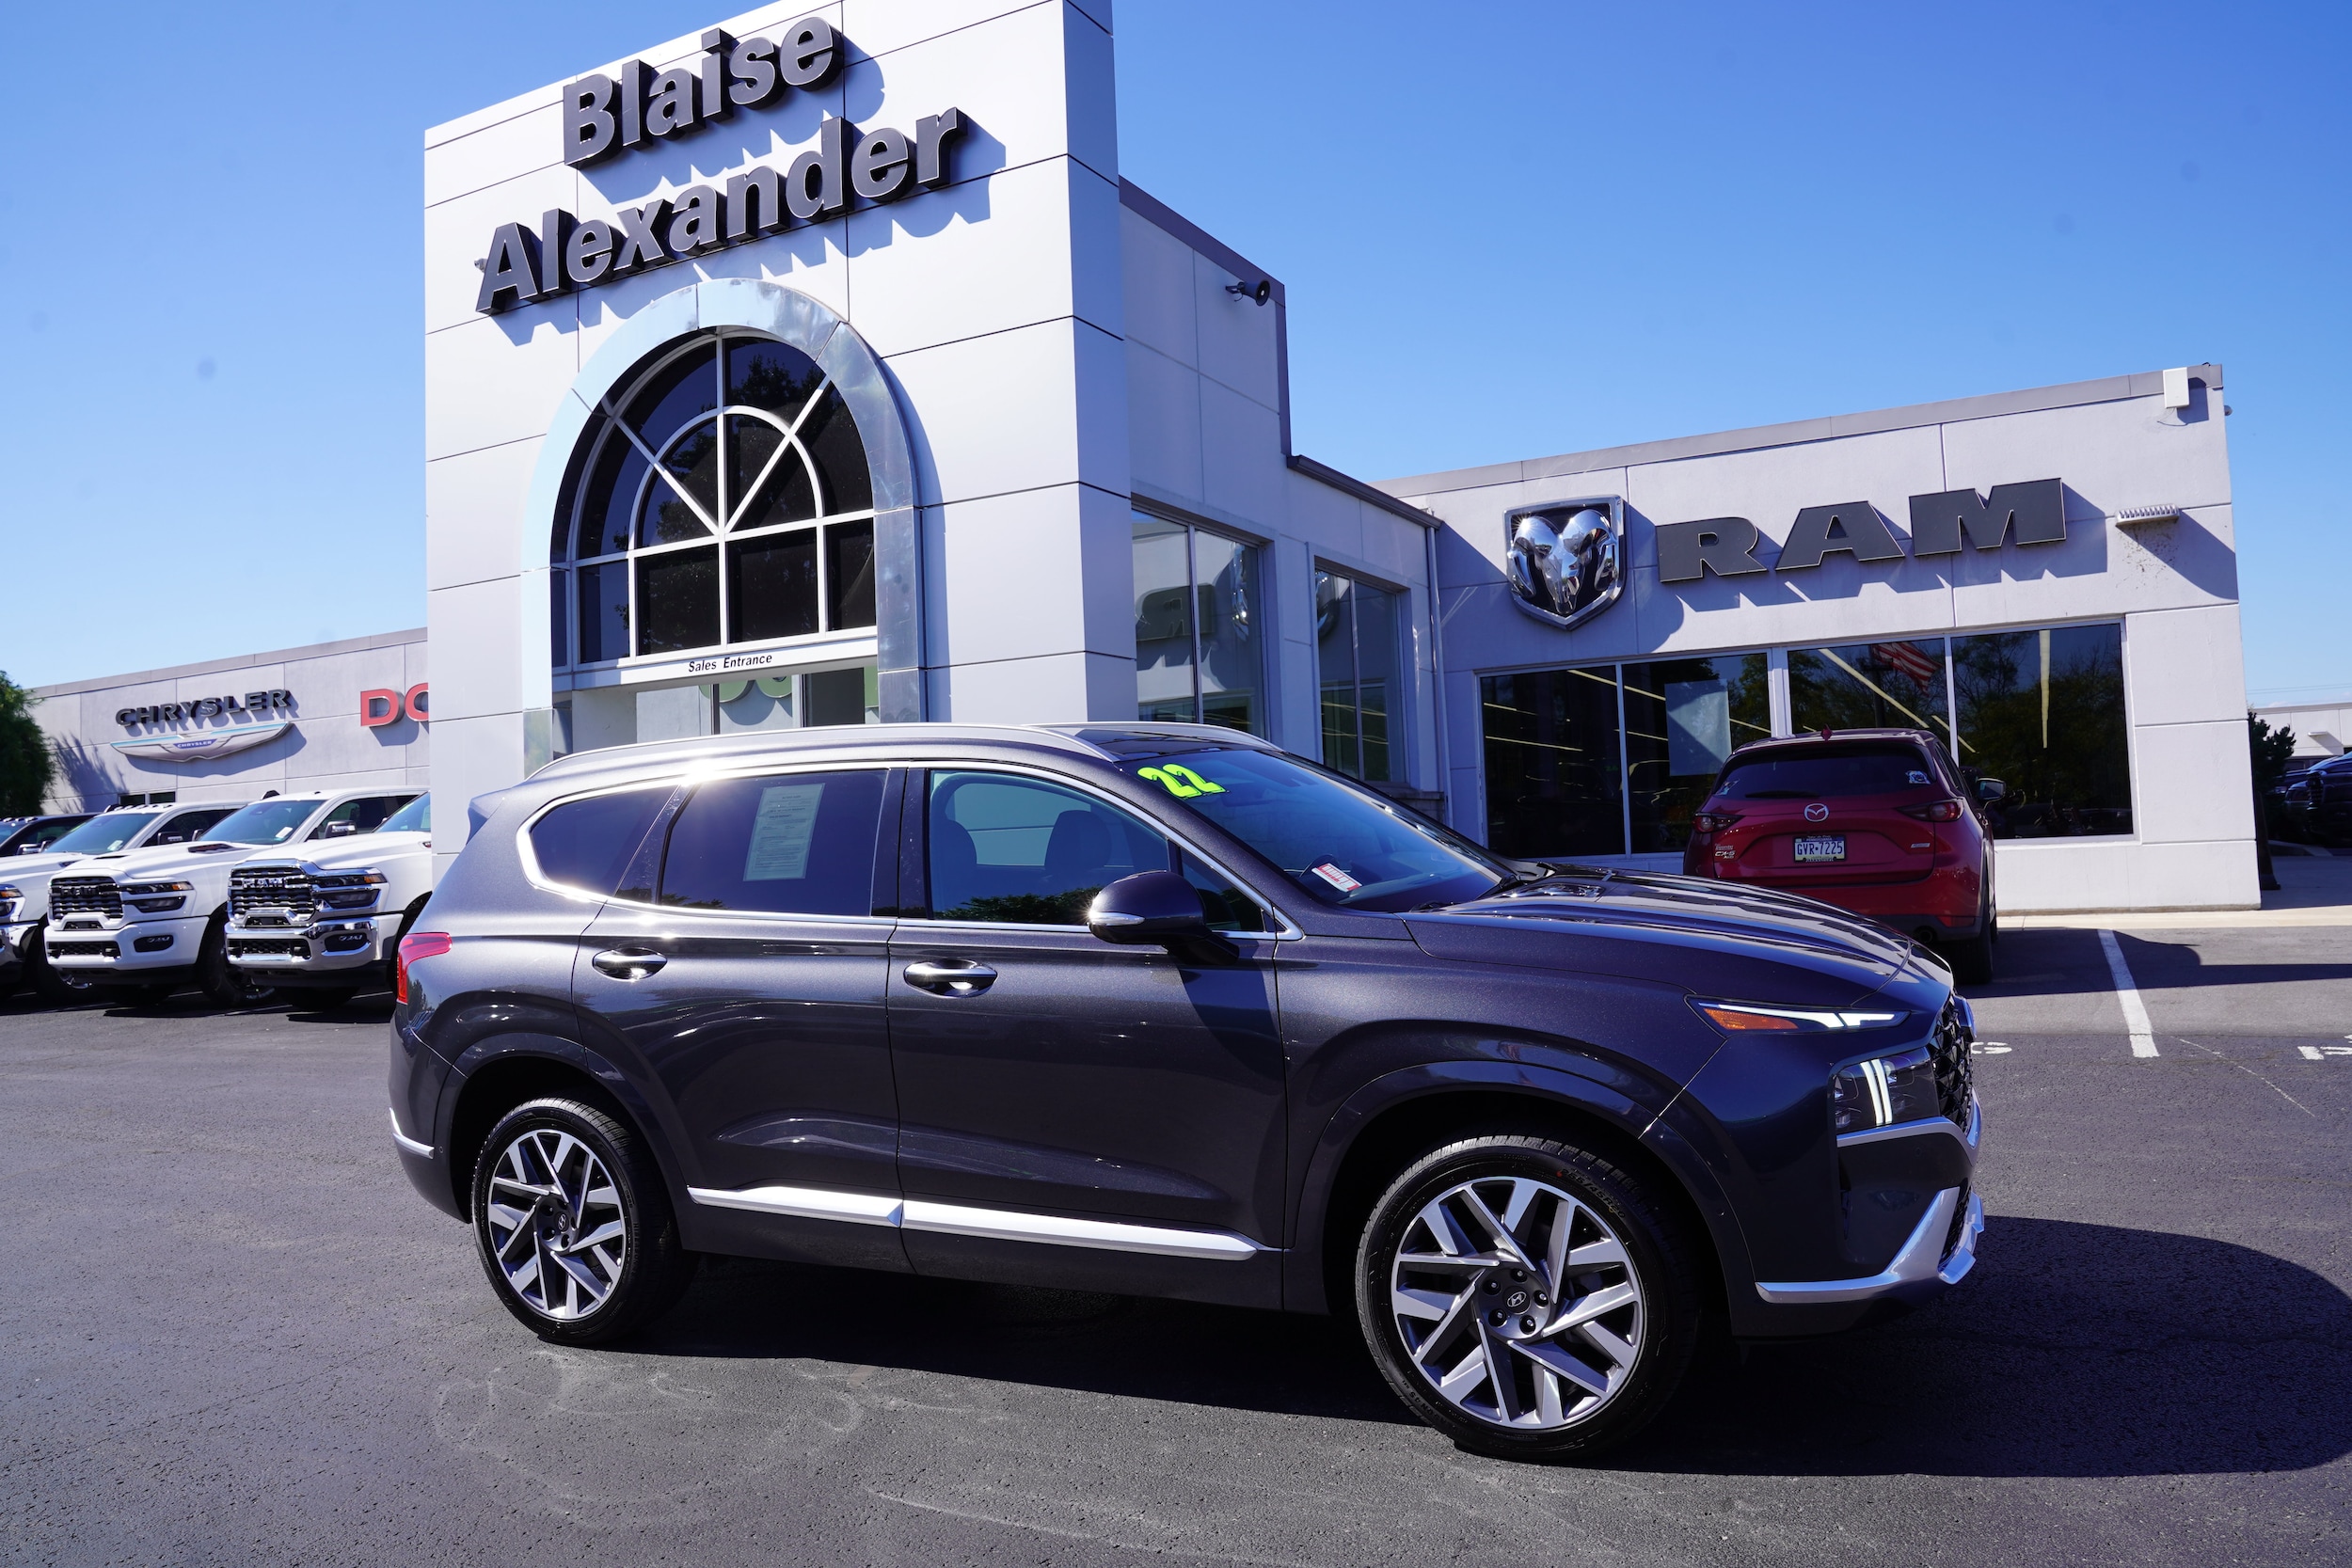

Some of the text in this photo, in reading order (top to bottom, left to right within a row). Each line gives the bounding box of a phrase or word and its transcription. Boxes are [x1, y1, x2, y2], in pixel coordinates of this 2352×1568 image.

[564, 17, 846, 169] Blaise
[476, 107, 968, 315] Alexander
[1656, 478, 2067, 583] RAM
[688, 655, 772, 673] Sales Entrance
[115, 689, 291, 727] CHRYSLER
[177, 739, 213, 749] CHRYSLER
[1136, 763, 1227, 800] 22
